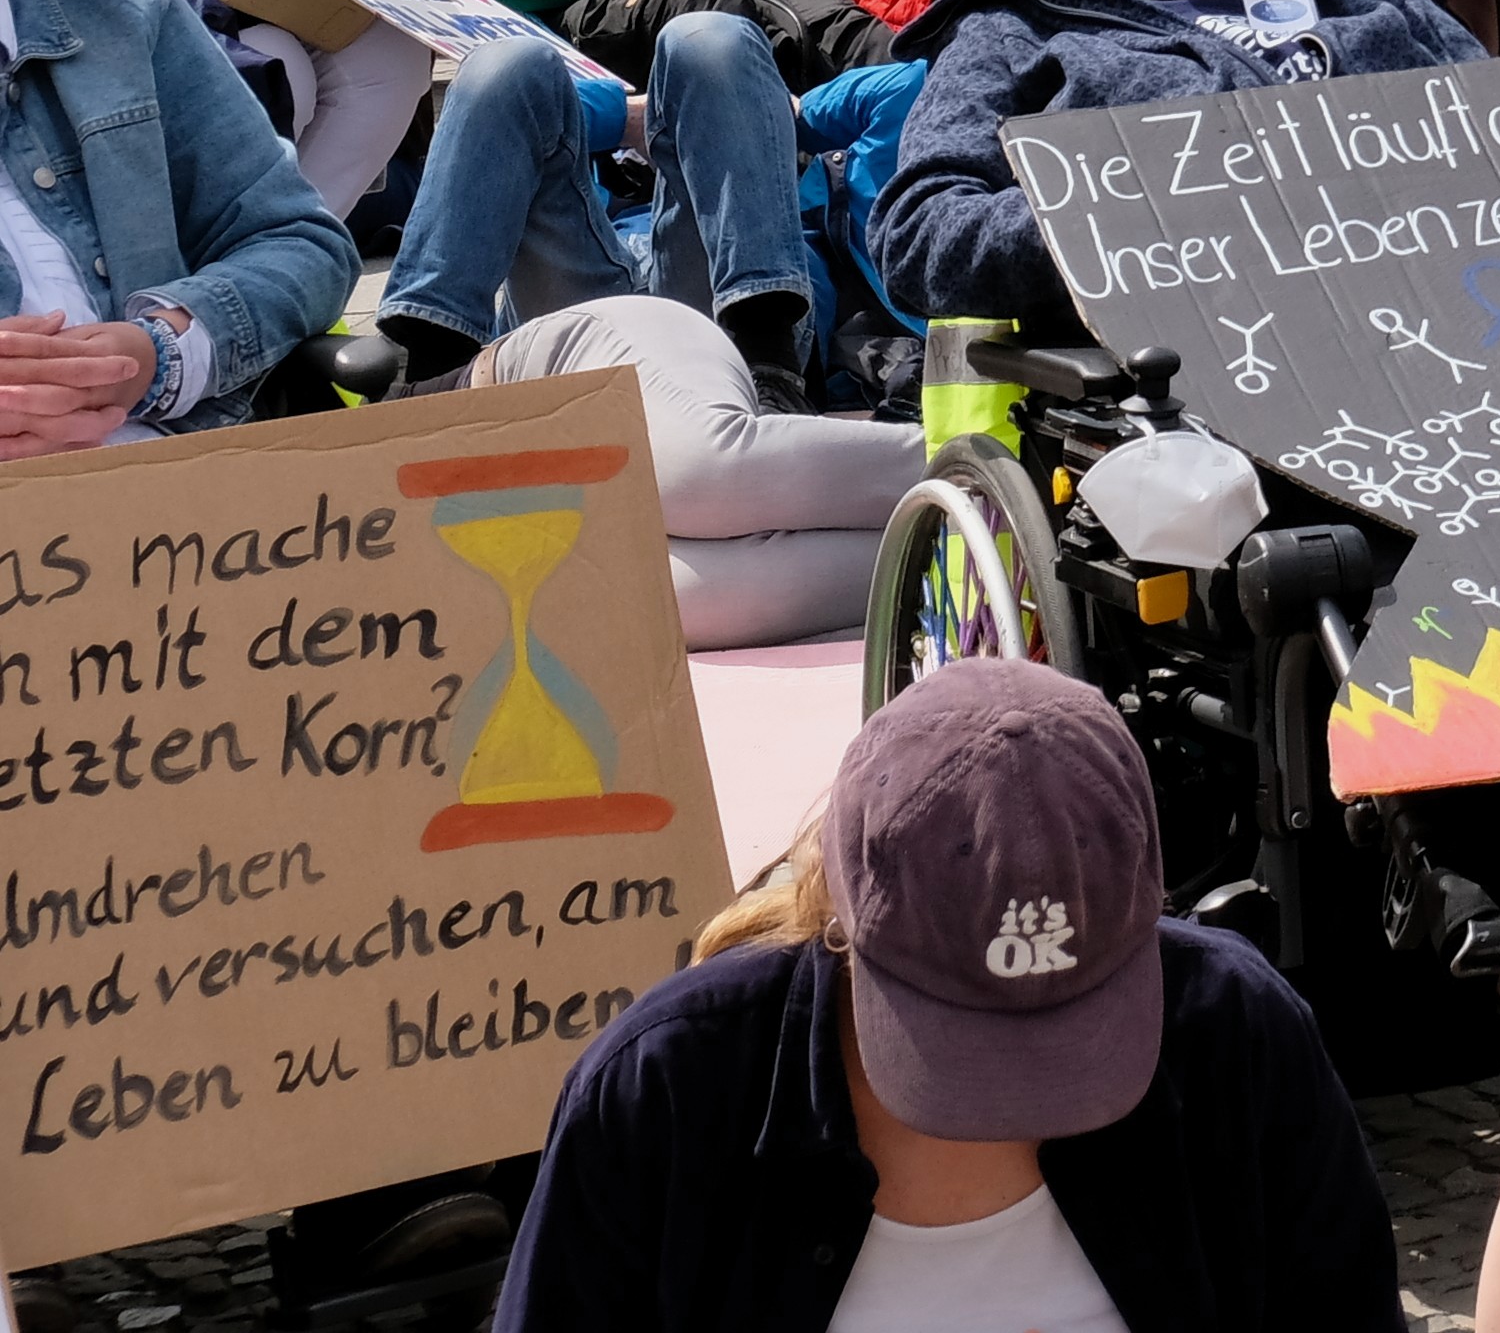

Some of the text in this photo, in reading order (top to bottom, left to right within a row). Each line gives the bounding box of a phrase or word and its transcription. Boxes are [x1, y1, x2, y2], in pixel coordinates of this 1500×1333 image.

[1005, 134, 1145, 212] Die
[1140, 98, 1315, 197] Zeit
[1318, 75, 1482, 172] läuft
[1041, 211, 1238, 300] Unser
[1239, 183, 1460, 276] Leben
[0, 492, 398, 610] as mache
[70, 603, 209, 704] mit
[246, 596, 449, 672] dem
[0, 672, 464, 810] etzten Korn?
[153, 886, 546, 1002] versuchen,
[557, 872, 680, 927] am
[19, 1053, 243, 1157] Leben
[272, 1036, 360, 1094] zu
